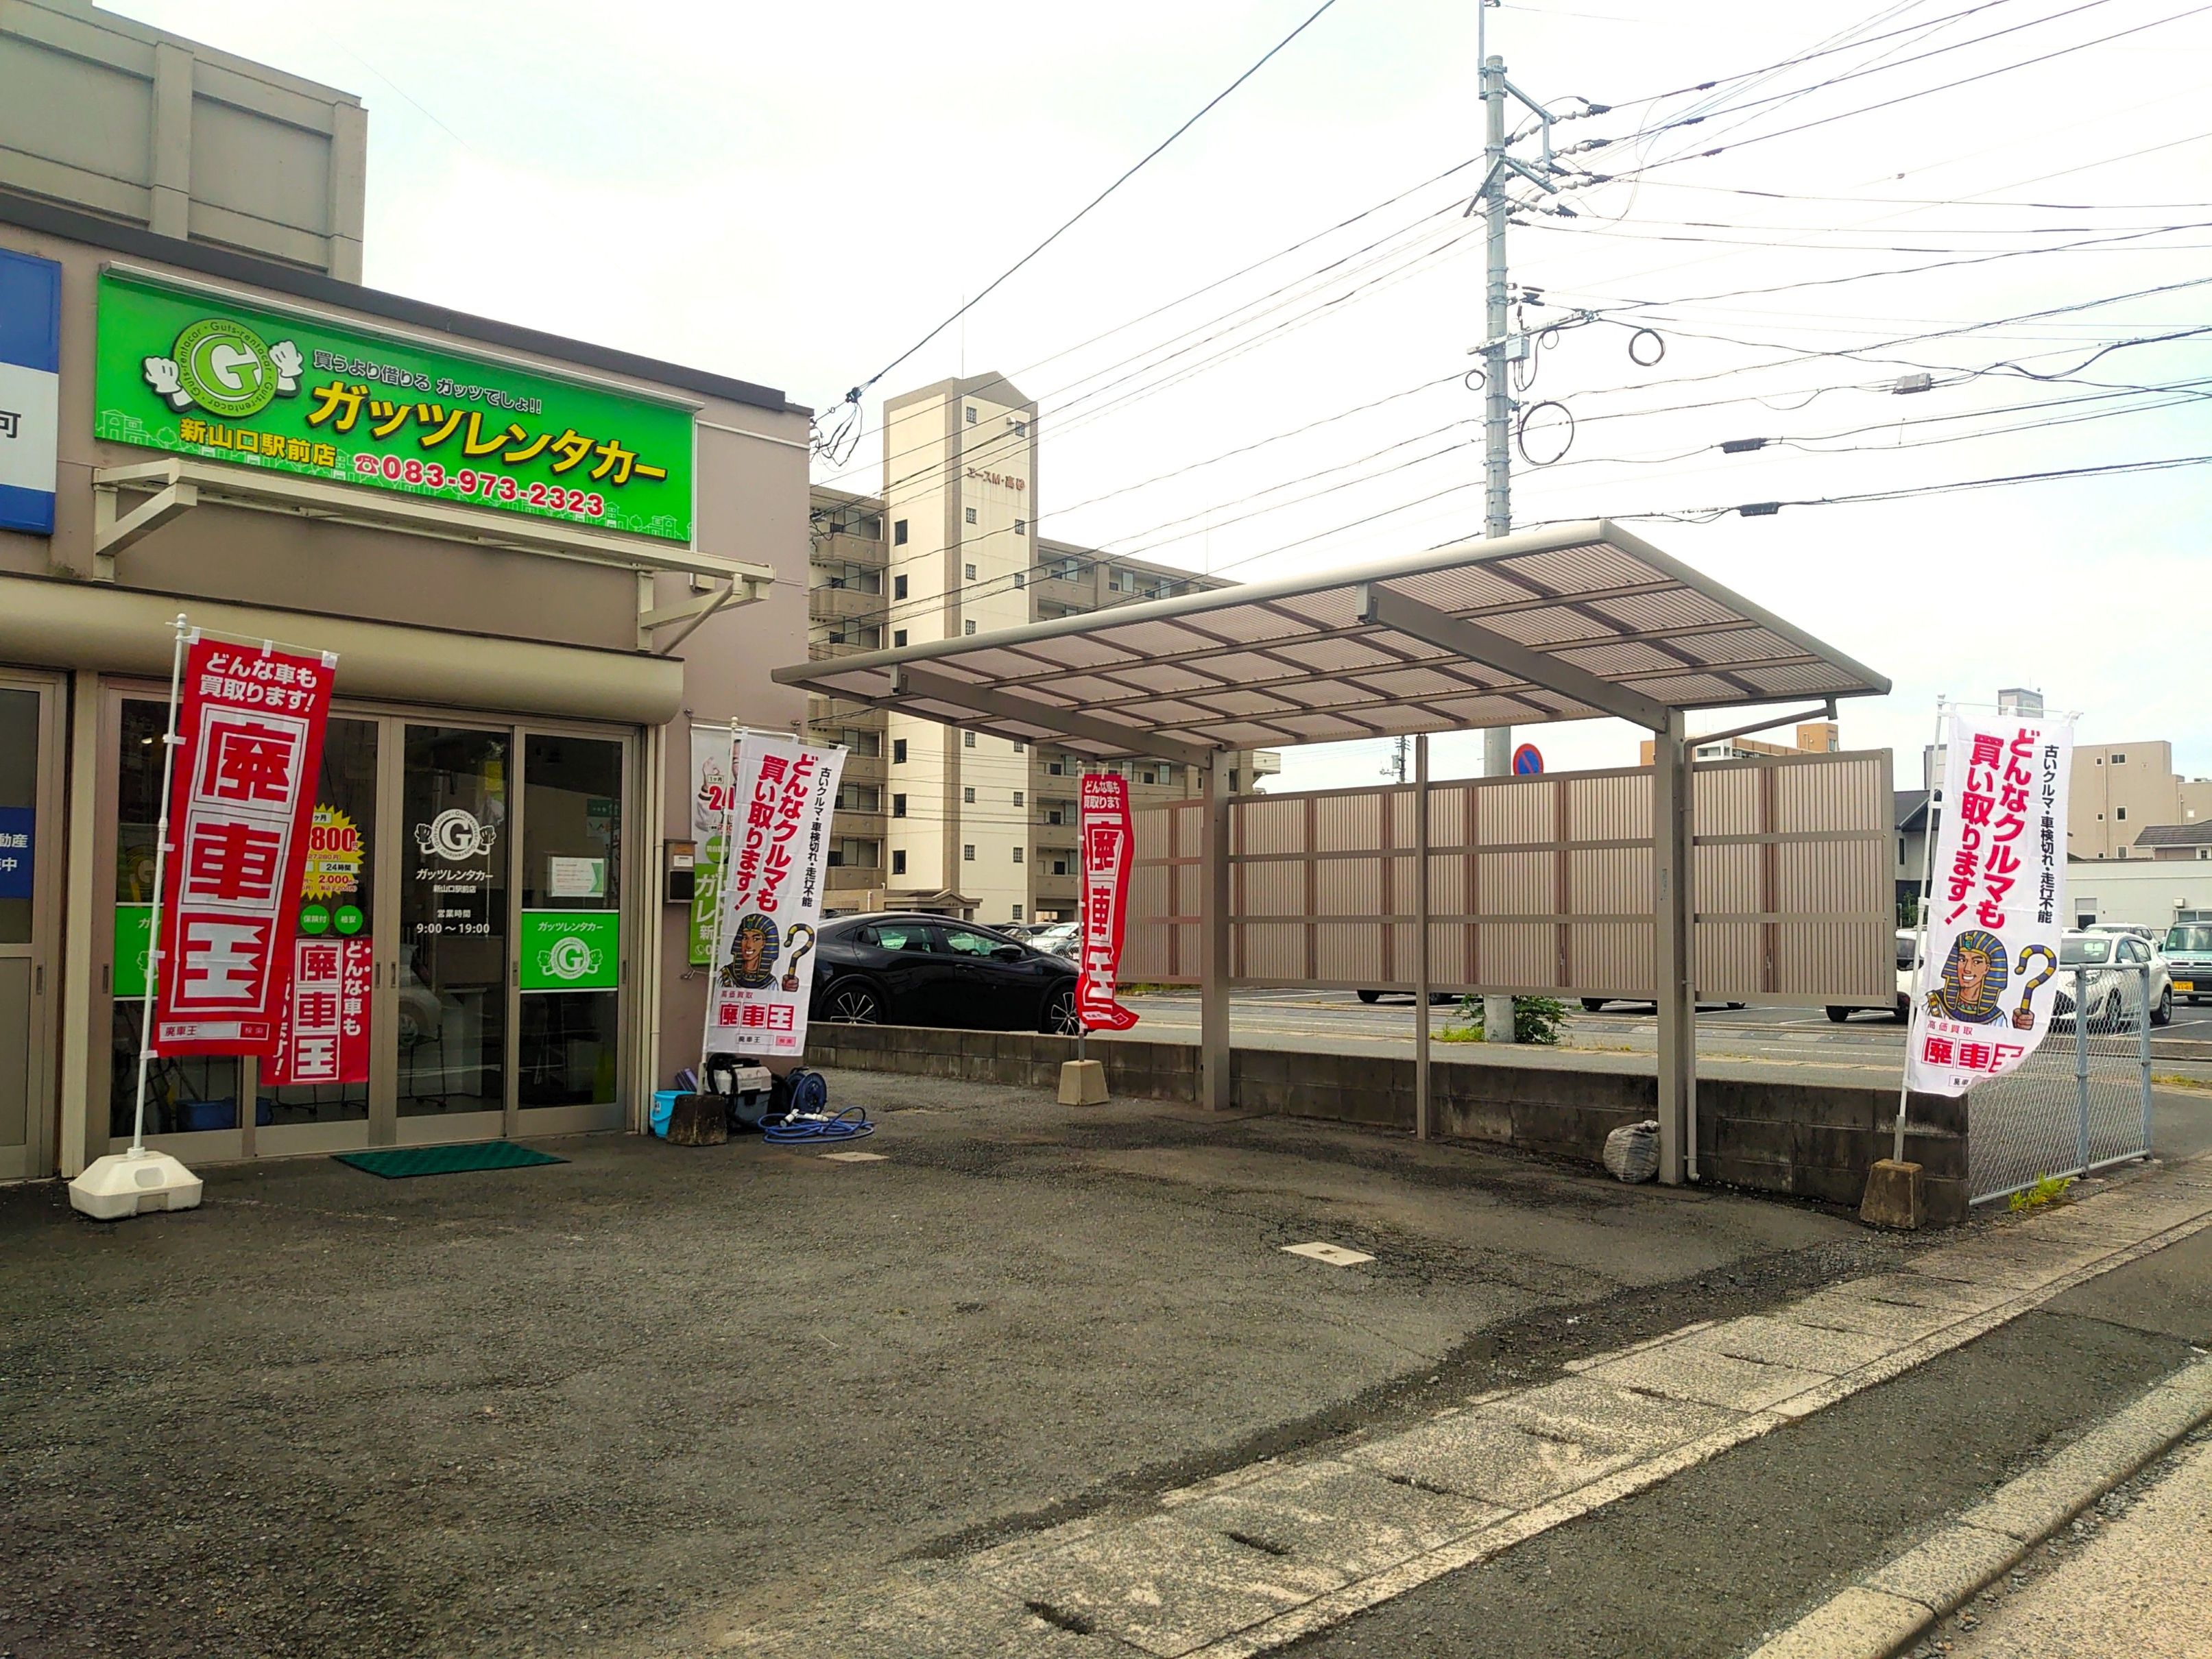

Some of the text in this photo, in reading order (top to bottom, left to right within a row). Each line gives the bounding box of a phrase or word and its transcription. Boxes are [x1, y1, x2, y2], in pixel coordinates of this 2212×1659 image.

[195, 336, 260, 397] G
[313, 349, 432, 391] 買うより借りる
[180, 417, 337, 468] 新山口駅前店
[306, 380, 668, 485] ガッツレンタカー
[382, 455, 604, 517] 083-973-2323
[206, 652, 317, 688] どんな車も
[199, 674, 316, 713] 買取ります!
[1083, 795, 1122, 809] 買取ります
[1085, 781, 1120, 794] どんな車も
[734, 754, 789, 911] 買い取ります!
[756, 753, 819, 912] どんなクルマも
[802, 767, 832, 908] 古いクルマ・車検切れ・走行不能
[1944, 733, 2004, 925] 買い取ります!
[1976, 728, 2041, 929] どんなクルマも
[2038, 744, 2059, 923] 古いクルマ・車検切れ・走行不能
[0, 857, 17, 871] 中
[182, 717, 302, 1002] 廃車王
[326, 863, 351, 871] 24時間
[416, 869, 493, 881] ガッツレンタカー
[437, 910, 471, 918] 営業時間
[538, 921, 603, 932] ガッツレンタカー
[298, 945, 339, 1076] 廃車王
[343, 941, 363, 1036] どんな車も
[165, 1026, 197, 1037] 廃車王
[719, 1003, 794, 1031] 廃車王
[1927, 1020, 1973, 1035] 高価買取
